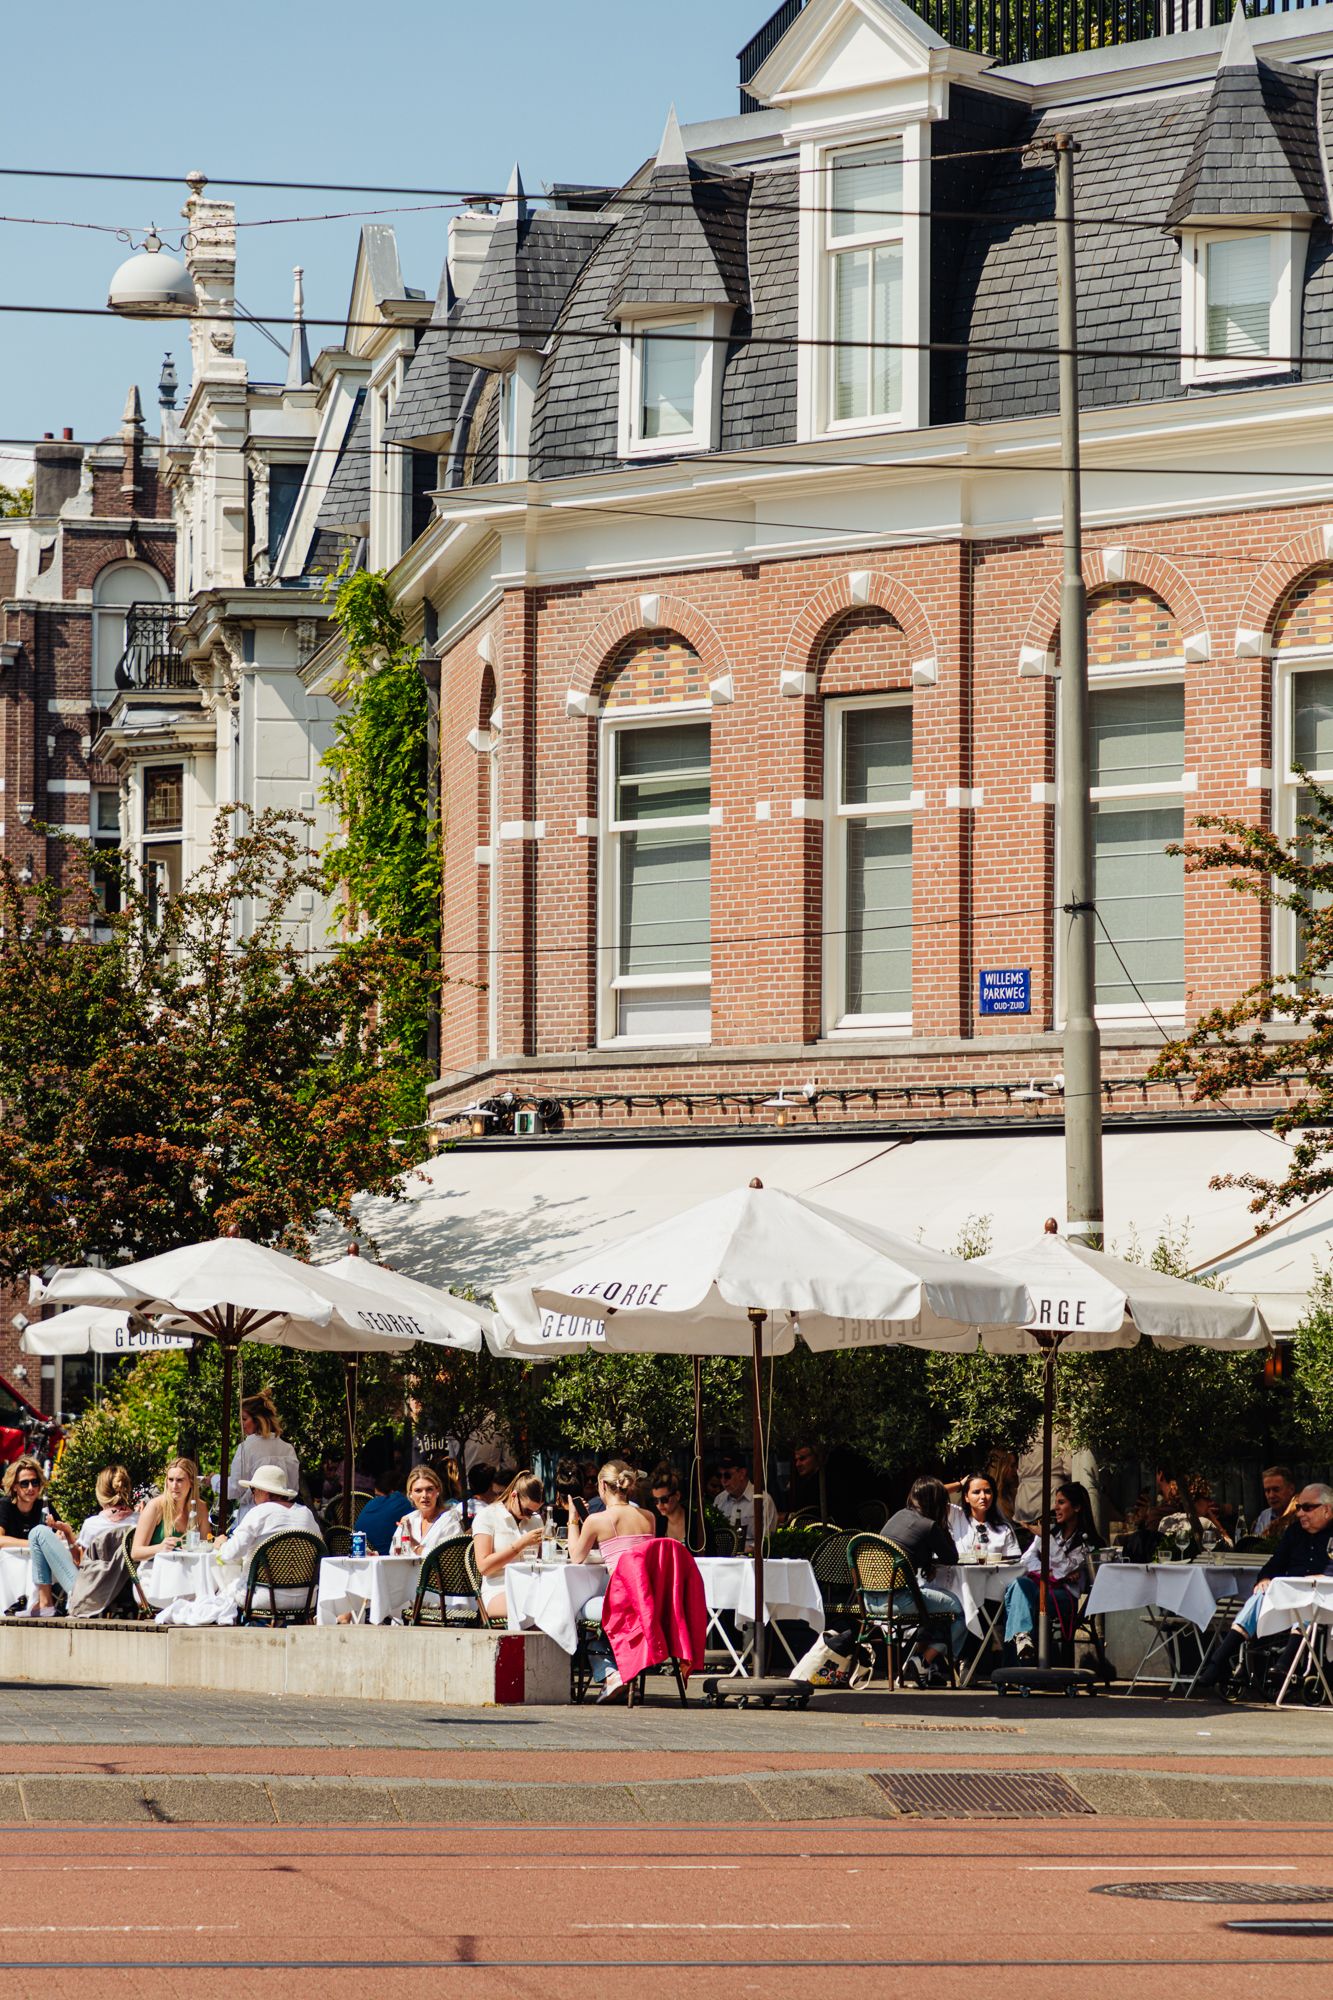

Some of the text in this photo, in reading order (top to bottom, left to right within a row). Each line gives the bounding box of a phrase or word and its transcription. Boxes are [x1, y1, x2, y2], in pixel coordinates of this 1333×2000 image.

[985, 972, 1024, 985] WILLEMS
[983, 986, 1025, 1000] PARKWEG
[993, 1001, 1025, 1010] OUD-ZUID
[571, 1281, 668, 1306] GEORGE
[357, 1311, 425, 1334] GEORGE
[1040, 1299, 1086, 1325] RGE
[542, 1314, 605, 1338] GEORG
